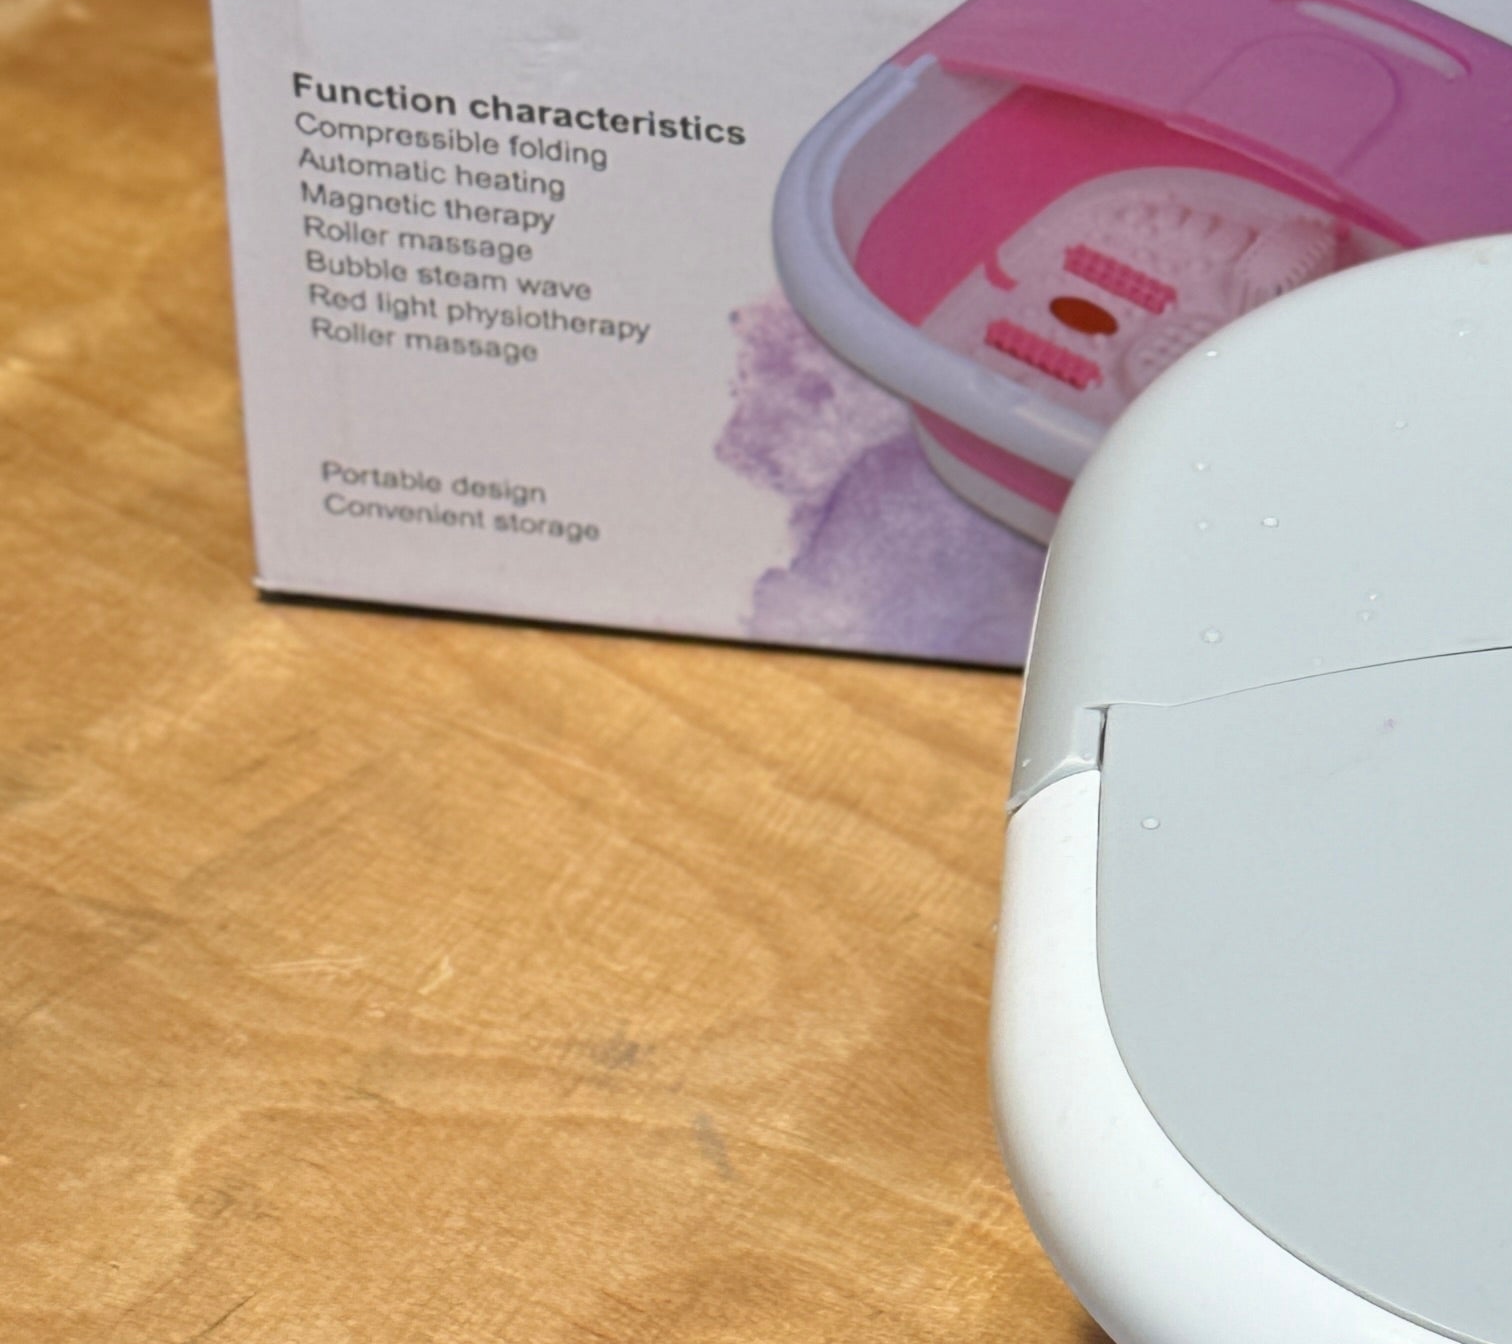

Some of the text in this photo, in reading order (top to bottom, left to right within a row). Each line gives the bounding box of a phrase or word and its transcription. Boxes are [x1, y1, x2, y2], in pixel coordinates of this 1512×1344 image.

[293, 72, 746, 146] Function characteristics
[295, 112, 608, 172] Compressible folding
[298, 148, 566, 201] Automatic heating
[301, 182, 555, 234] Magnetic therapy
[303, 216, 533, 264] Roller massage
[306, 250, 592, 301] Bubble steam wave
[309, 284, 650, 344] Red light physiotherapy
[311, 318, 538, 364] Roller massage
[322, 461, 546, 505] Portable design
[324, 494, 600, 543] Convenient storage
